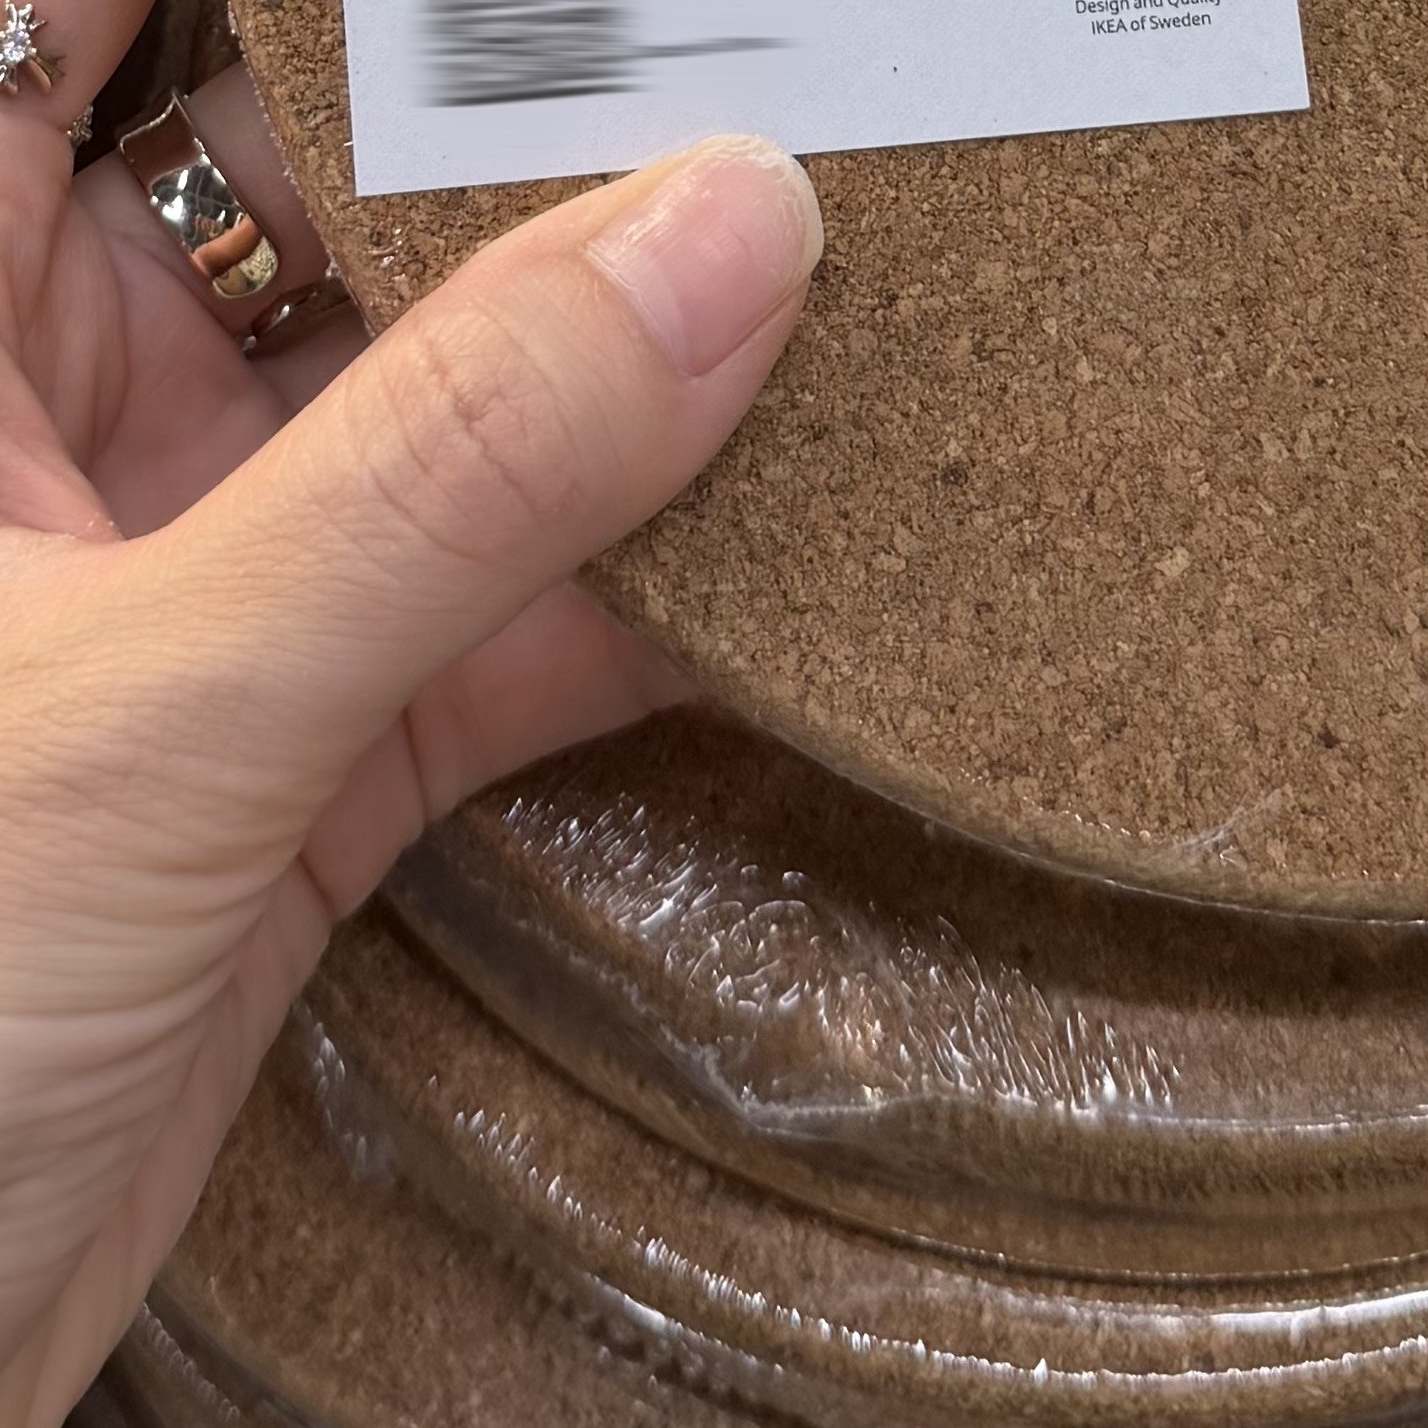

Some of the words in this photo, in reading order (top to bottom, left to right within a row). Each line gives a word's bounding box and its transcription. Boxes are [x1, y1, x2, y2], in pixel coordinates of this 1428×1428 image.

[1091, 17, 1128, 35] IKEA
[1130, 15, 1147, 31] of
[1149, 12, 1212, 30] Sweden
